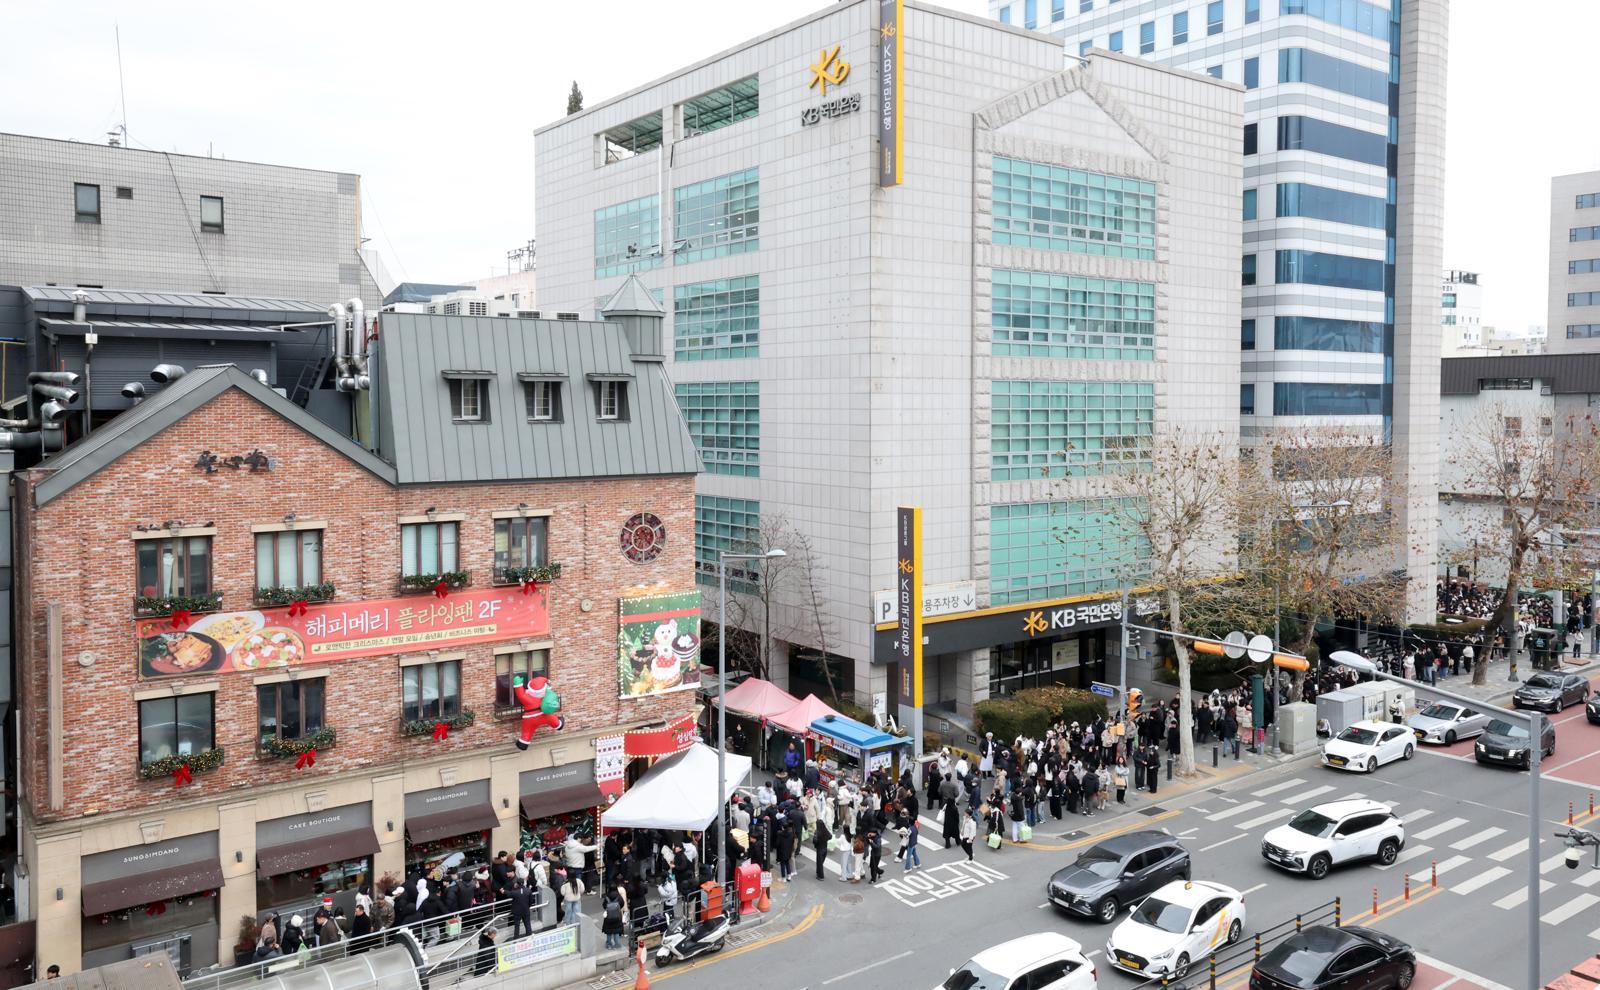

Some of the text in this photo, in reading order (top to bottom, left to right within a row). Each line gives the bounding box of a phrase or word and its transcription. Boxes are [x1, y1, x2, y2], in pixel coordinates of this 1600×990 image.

[884, 44, 892, 130] KB국민은행
[801, 93, 861, 127] KB국민은행
[305, 600, 502, 638] 해피메리 플라잉팬 2F
[882, 595, 960, 620] P 용주차장
[901, 579, 910, 656] KB국민은행
[1051, 601, 1122, 630] KB국민은행
[325, 641, 351, 651] 로맨틱한
[353, 639, 384, 648] 크리스마스
[426, 790, 468, 803] SUNGSIMDANG
[288, 815, 340, 830] CAKE BOUTIQUE
[123, 847, 179, 863] SUNGSIMDANG
[873, 859, 1010, 908] 진입금지
